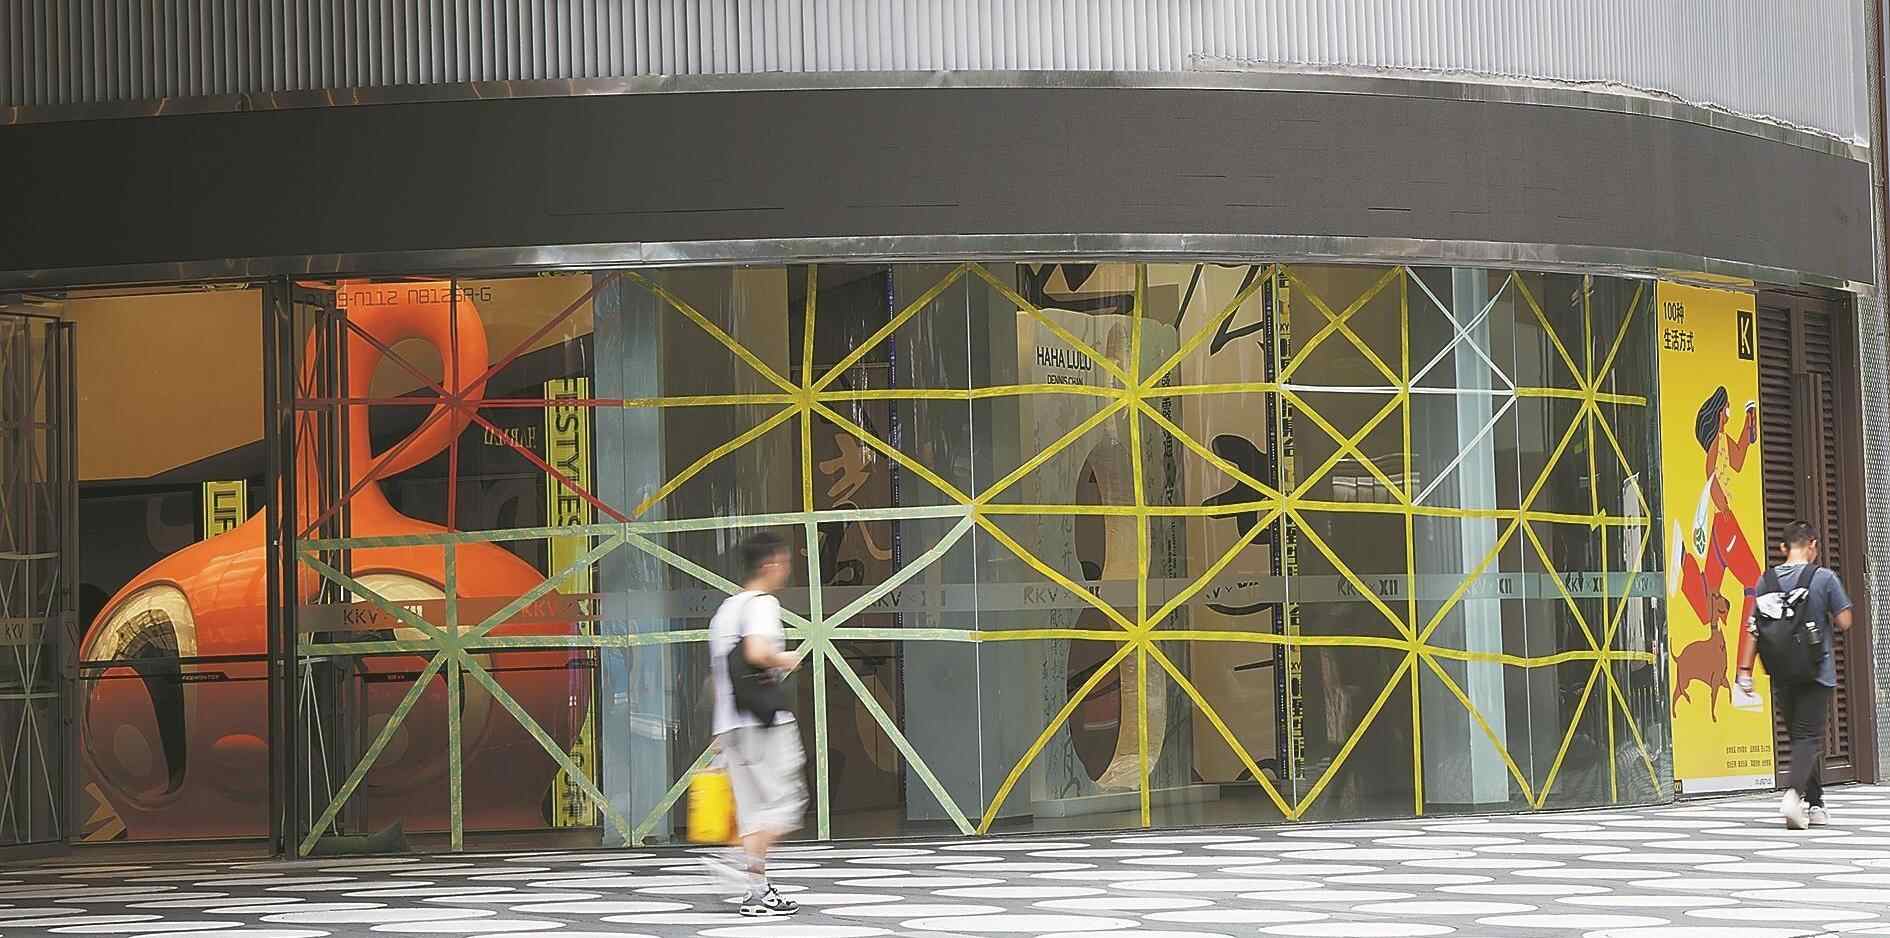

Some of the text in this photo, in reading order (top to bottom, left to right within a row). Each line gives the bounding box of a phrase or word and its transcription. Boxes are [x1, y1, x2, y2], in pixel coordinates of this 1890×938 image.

[1664, 302, 1685, 324] 100种
[1664, 328, 1695, 352] 生活方式
[1036, 346, 1065, 368] HAHA
[344, 608, 378, 625] KKV
